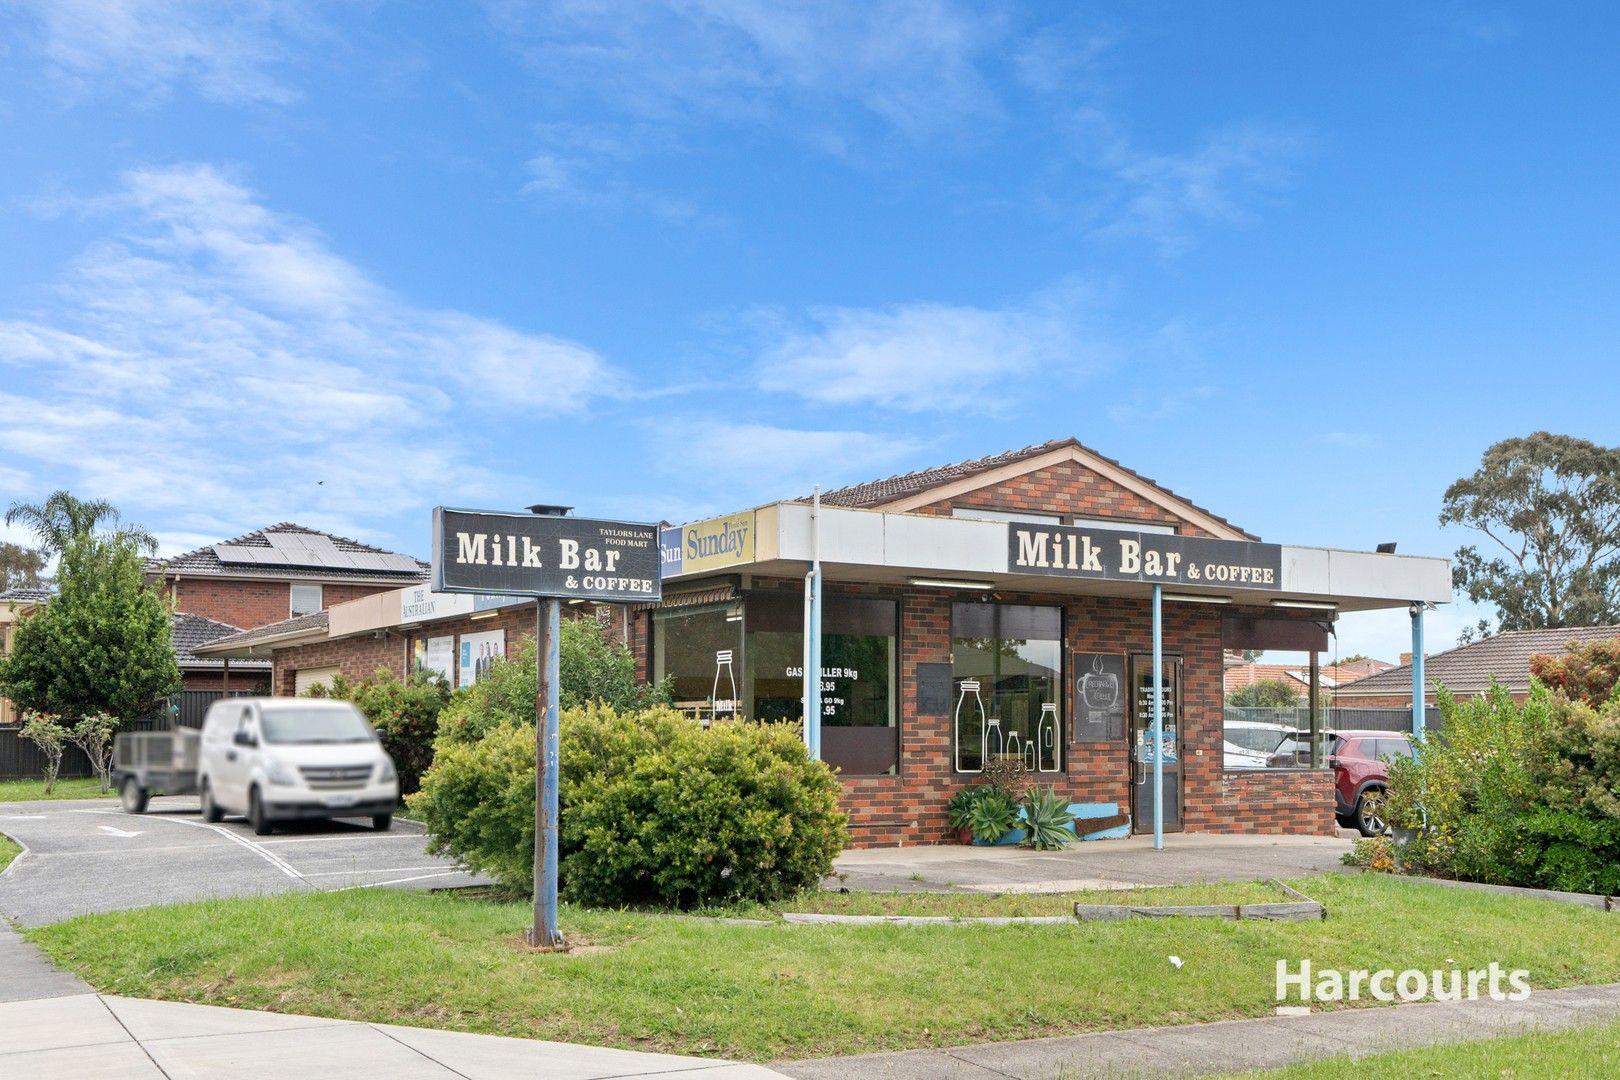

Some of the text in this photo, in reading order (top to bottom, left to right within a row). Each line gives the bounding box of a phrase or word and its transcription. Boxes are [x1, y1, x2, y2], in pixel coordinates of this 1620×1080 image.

[600, 529, 654, 539] TAYLORS LANE
[687, 521, 748, 559] Sunday
[605, 537, 627, 546] FOOD
[456, 532, 621, 572] Milk Bar
[661, 543, 681, 564] Sun
[1016, 530, 1274, 584] Milk Bar & COFFEE
[565, 575, 653, 593] & COFFEE
[414, 590, 424, 602] THE
[403, 601, 435, 617] AUSTRALIAN
[786, 667, 802, 677] GAS
[843, 668, 858, 679] 9kg
[820, 681, 835, 691] 6.95
[834, 697, 844, 705] 9kg
